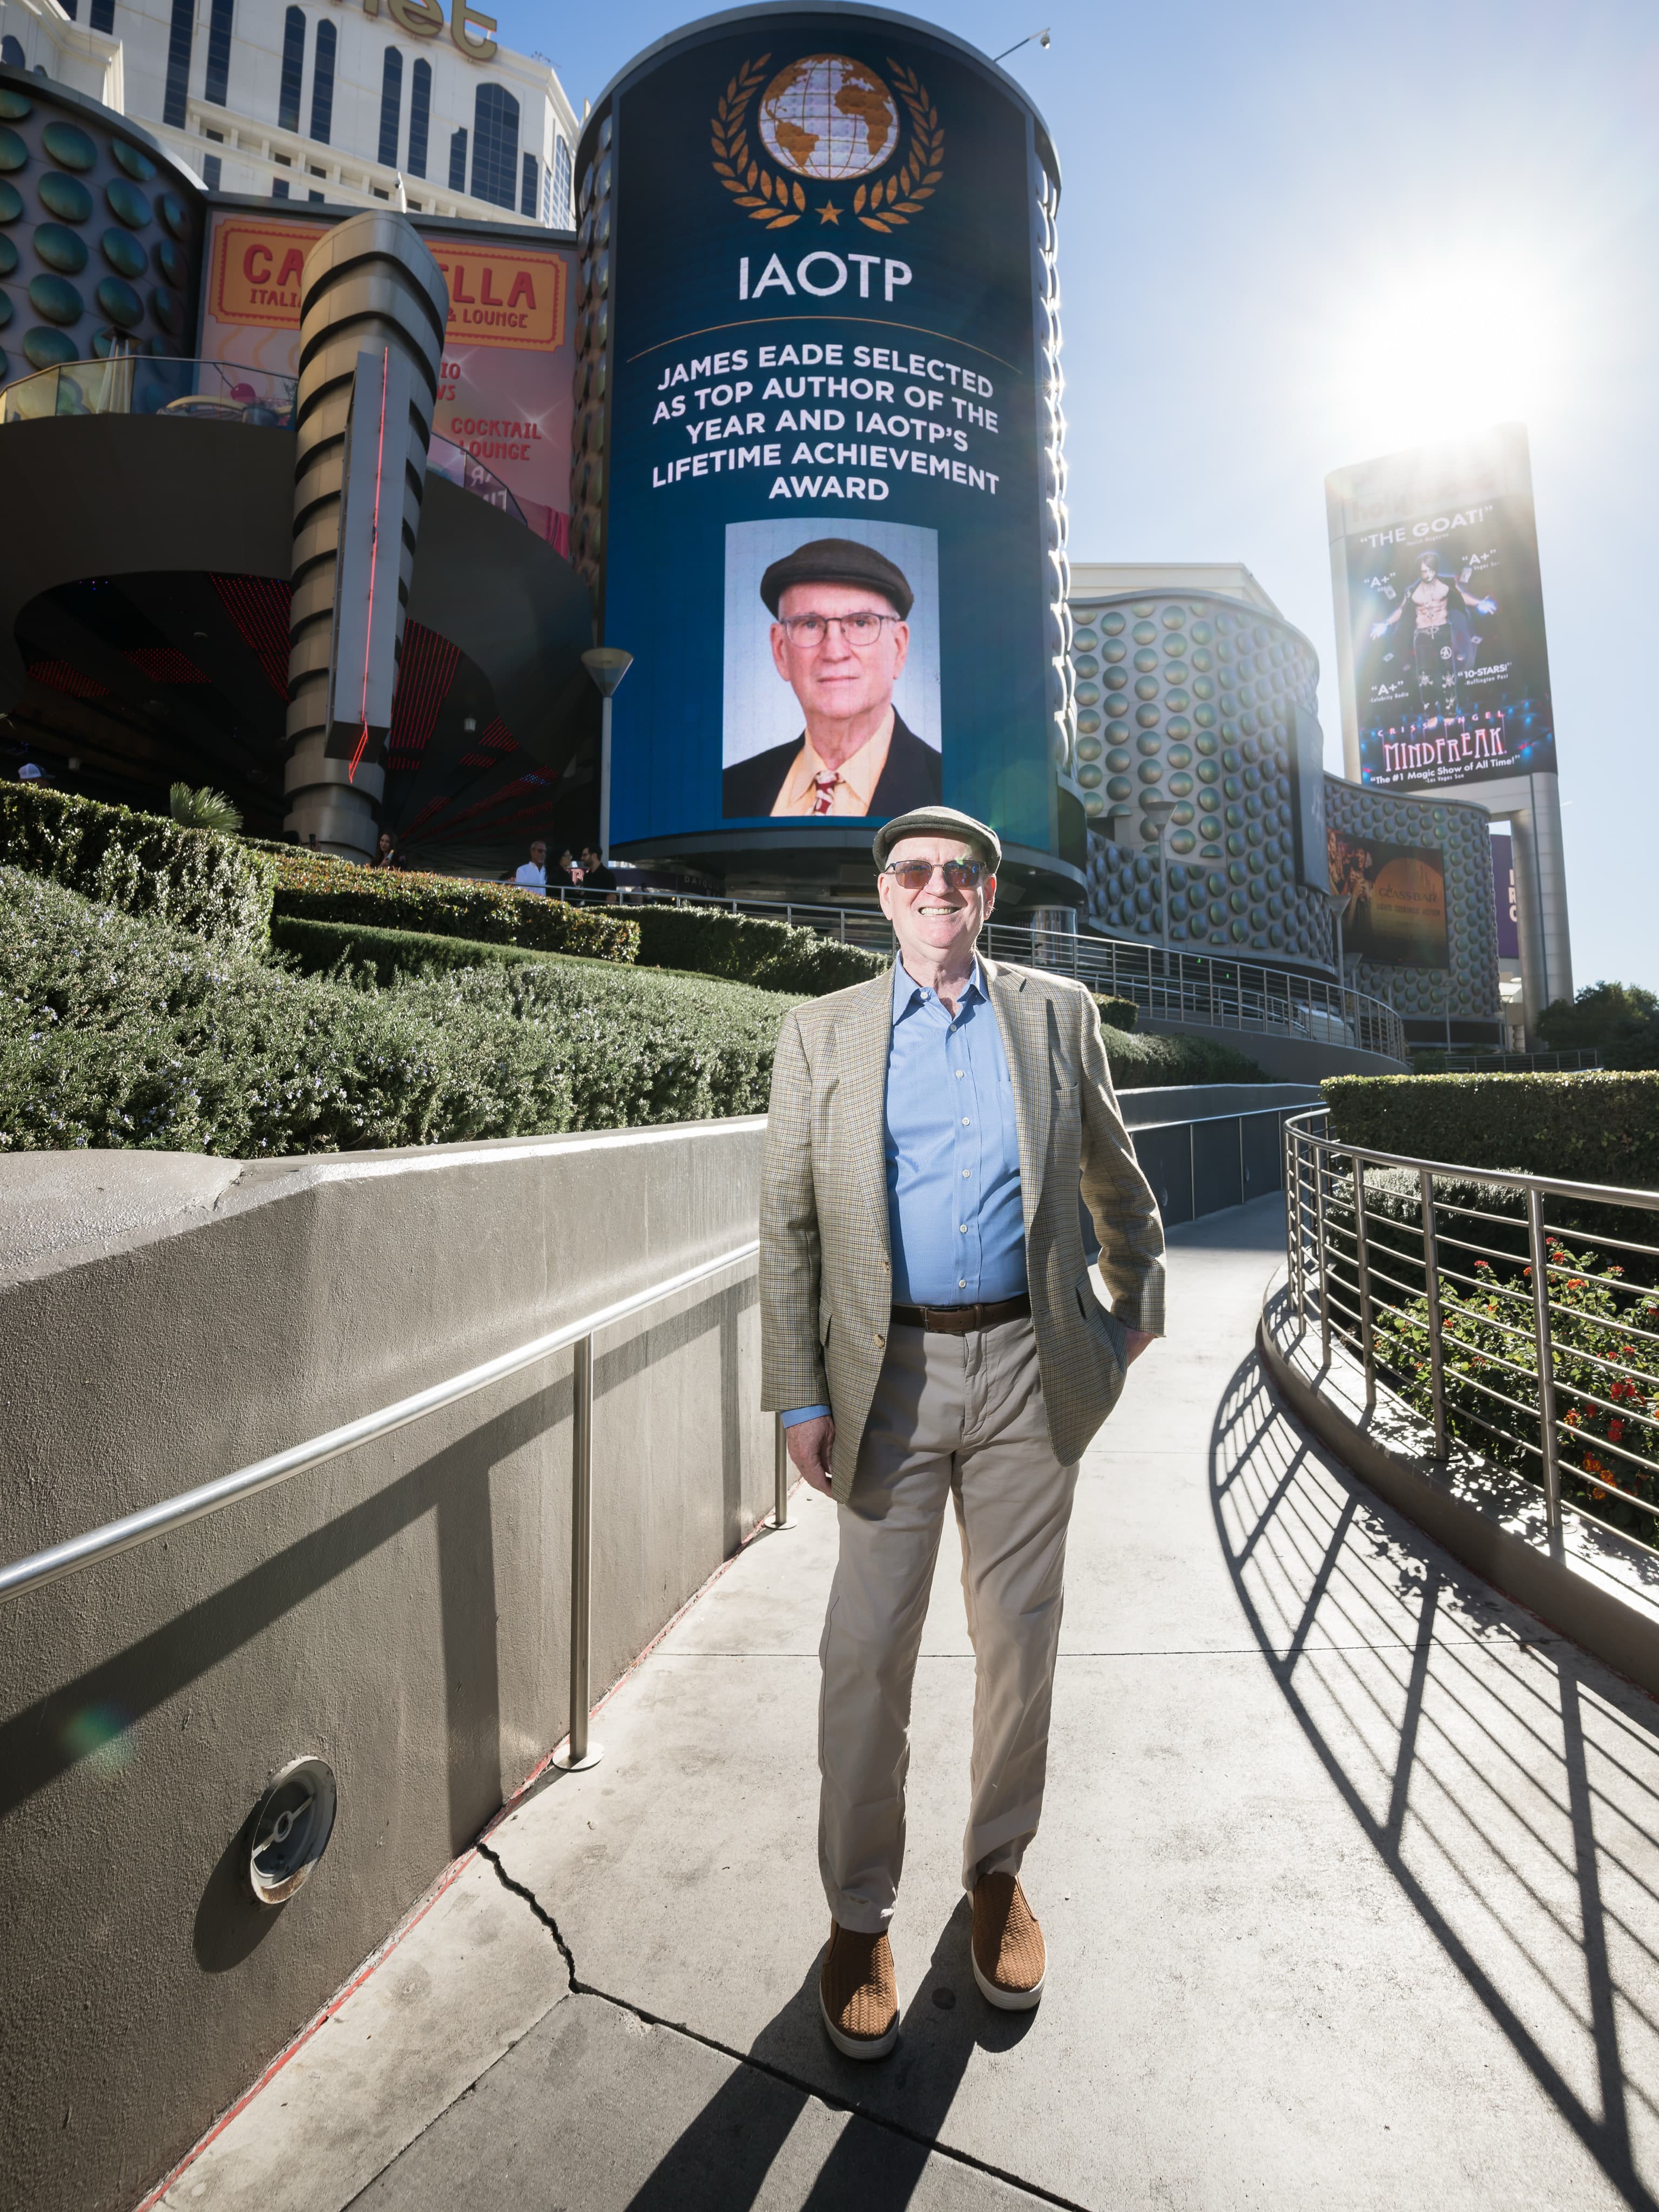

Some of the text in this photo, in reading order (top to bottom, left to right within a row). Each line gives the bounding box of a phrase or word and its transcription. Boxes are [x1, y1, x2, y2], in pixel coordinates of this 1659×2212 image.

[439, 263, 536, 310] LLA
[739, 251, 913, 302] IAOTP
[463, 308, 528, 329] LOUNGE
[657, 344, 993, 398] JAMES EADE SELECTED
[652, 376, 999, 434] AS TOP AUTHOR OF THE
[451, 417, 541, 440] COCKTAIL
[686, 409, 968, 452] YEAR AND IAOTP’S
[460, 440, 531, 461] LOUNGE
[653, 442, 1000, 495] LIFETIME ACHIEVEMENT
[768, 476, 889, 501] AWARD
[1393, 773, 1404, 782] #1
[1407, 770, 1435, 780] Magic
[1438, 765, 1462, 775] Show
[1464, 762, 1474, 771] of
[1475, 760, 1488, 770] All
